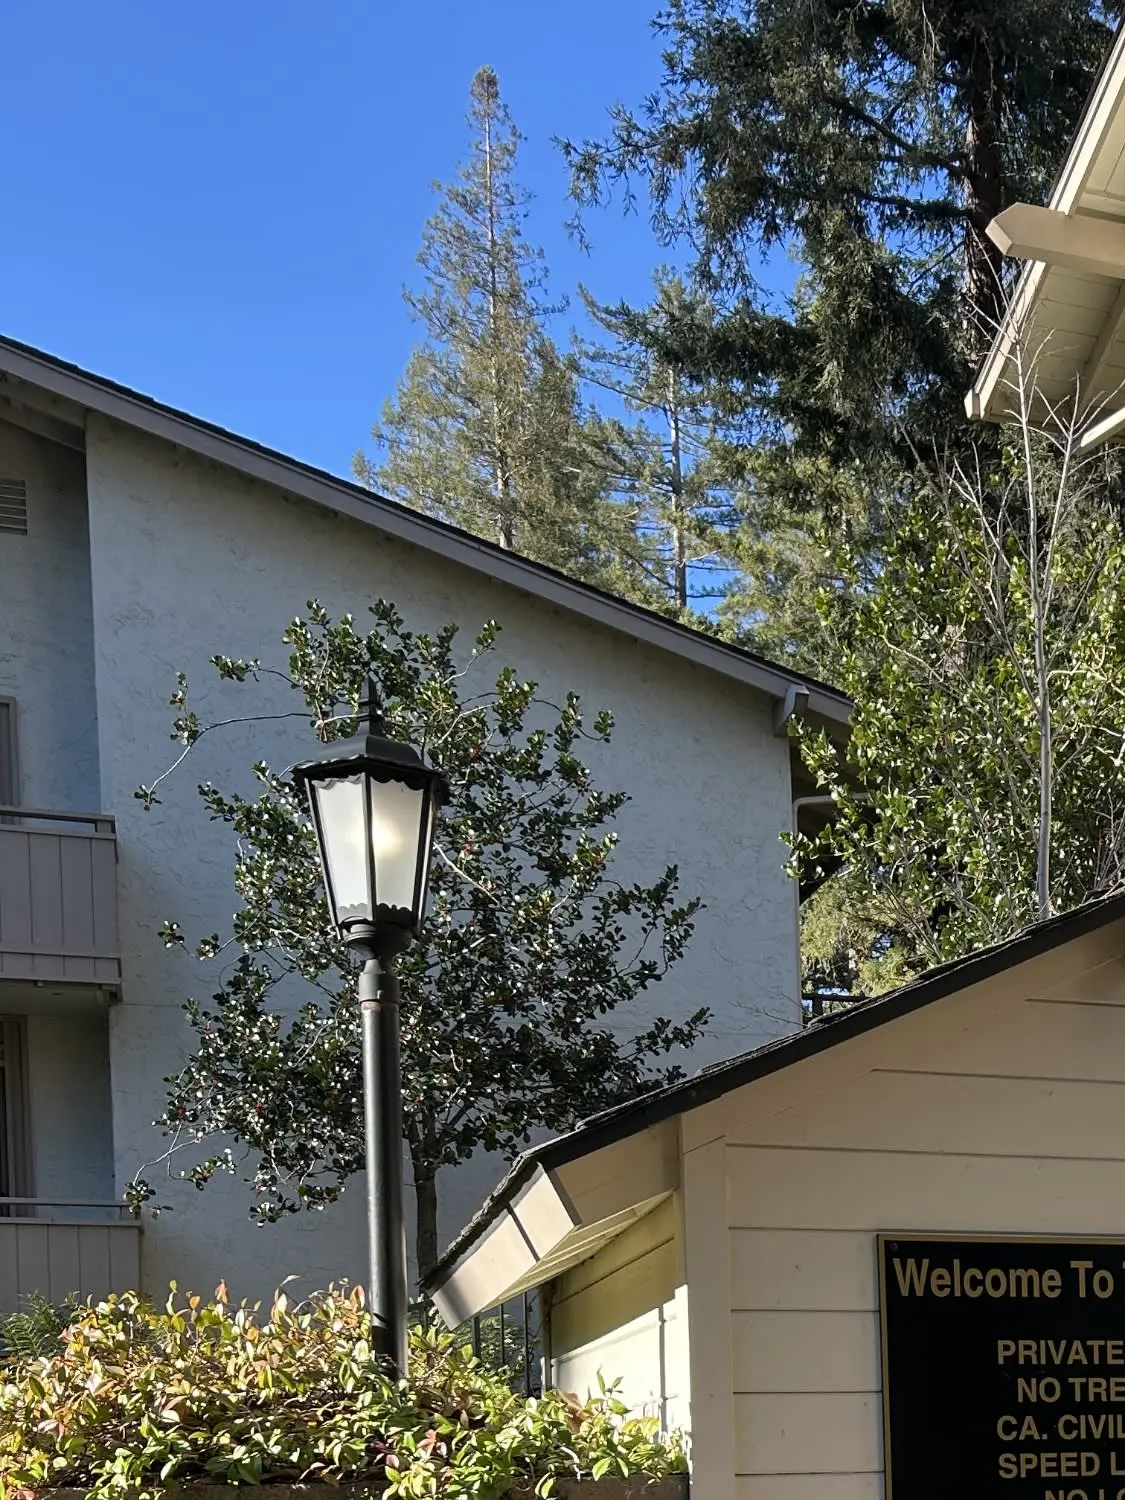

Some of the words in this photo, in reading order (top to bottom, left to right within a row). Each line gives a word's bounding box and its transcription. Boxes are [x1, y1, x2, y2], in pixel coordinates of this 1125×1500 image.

[892, 1257, 1063, 1299] Welcome
[1069, 1260, 1114, 1299] To
[997, 1339, 1125, 1365] PRIVATE
[1017, 1376, 1061, 1403] NO
[996, 1415, 1048, 1441] CA.
[998, 1451, 1101, 1479] SPEED
